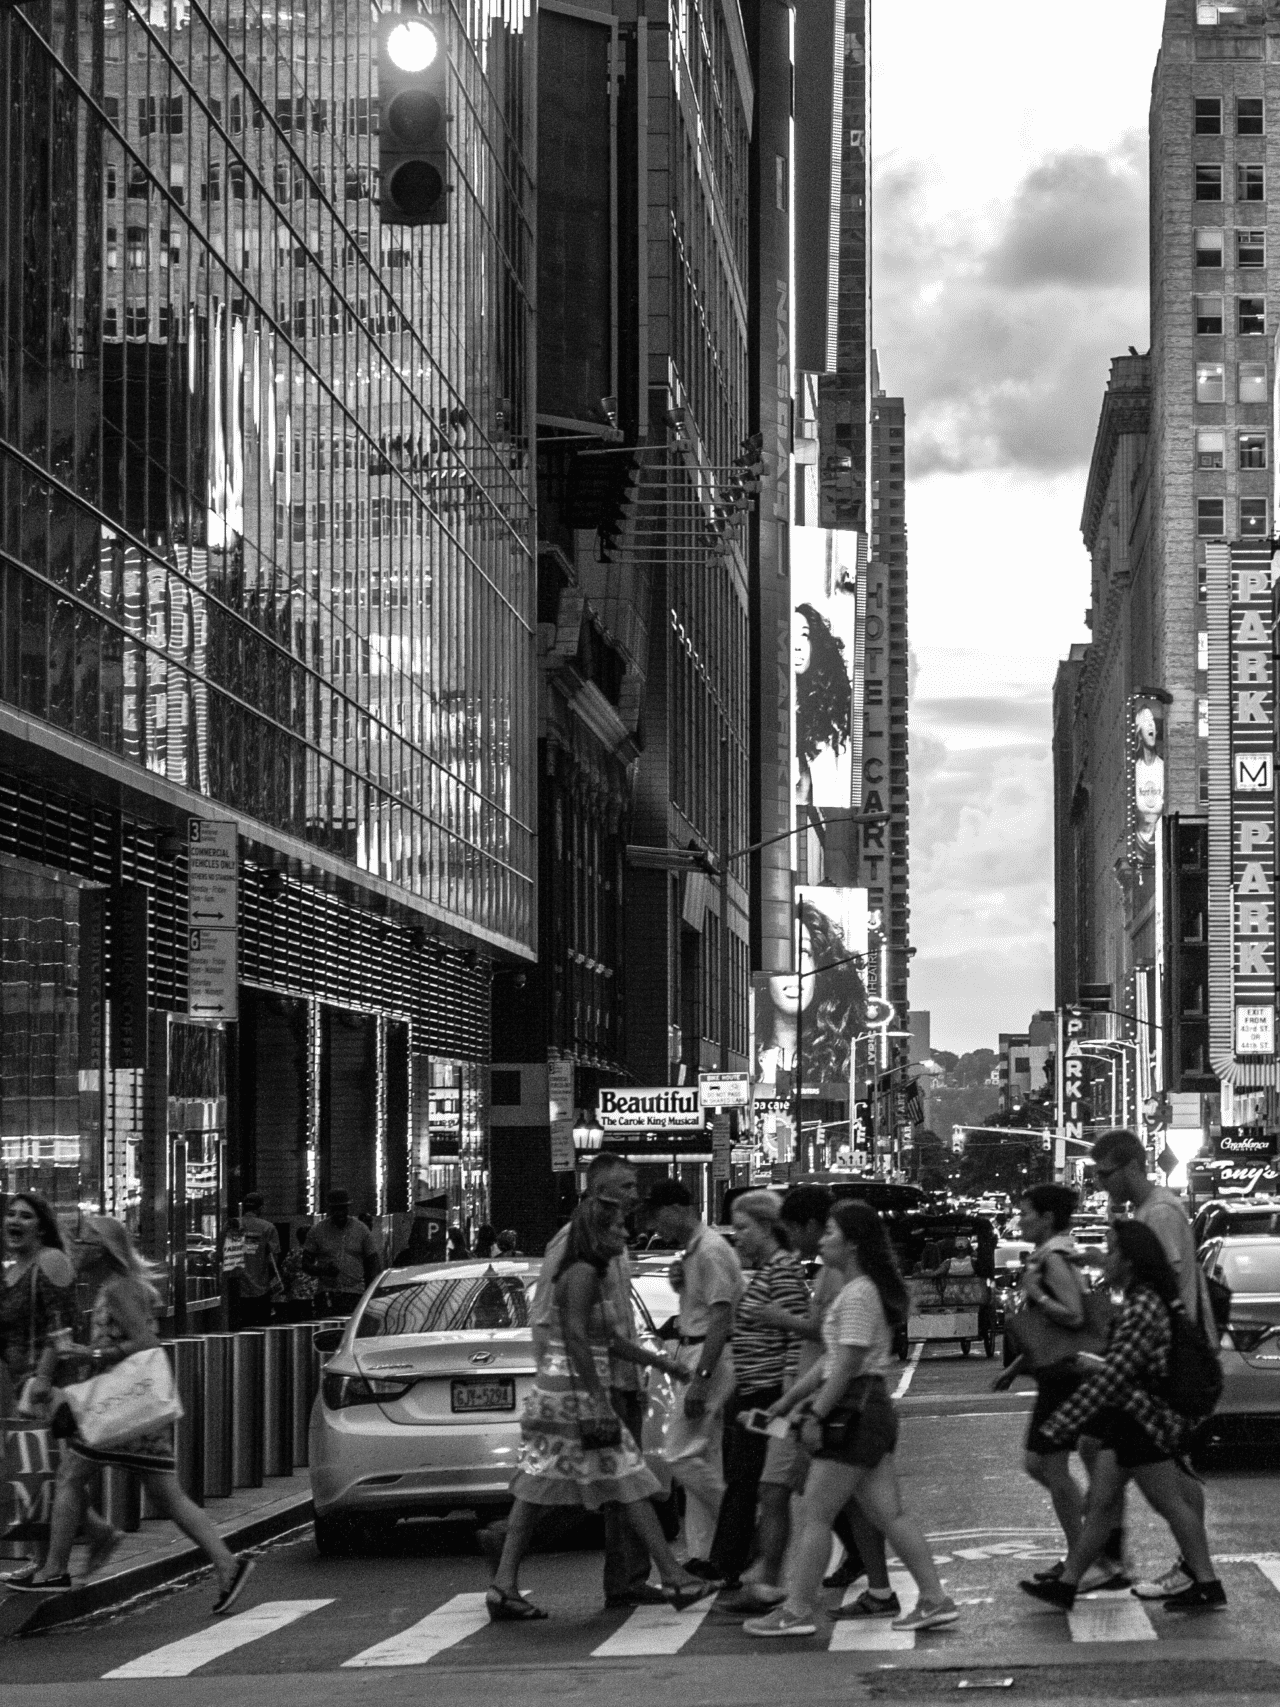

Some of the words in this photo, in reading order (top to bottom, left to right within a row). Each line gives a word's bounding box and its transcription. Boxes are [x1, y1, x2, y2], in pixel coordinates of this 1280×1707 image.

[863, 582, 883, 738] HOTEL
[1238, 571, 1270, 724] PARK
[191, 822, 199, 841] 3
[1239, 821, 1271, 976] PARK
[191, 931, 199, 949] 6
[867, 948, 878, 996] THEATRE
[1065, 1019, 1083, 1140] PARKIN
[600, 1090, 699, 1114] Beautiful
[601, 1117, 617, 1126] The
[618, 1117, 645, 1126] Carole
[647, 1116, 666, 1127] King
[668, 1116, 700, 1126] Musical
[1220, 1137, 1270, 1151] Casablanca
[1203, 1160, 1279, 1195] Tony's
[427, 1222, 440, 1240] P
